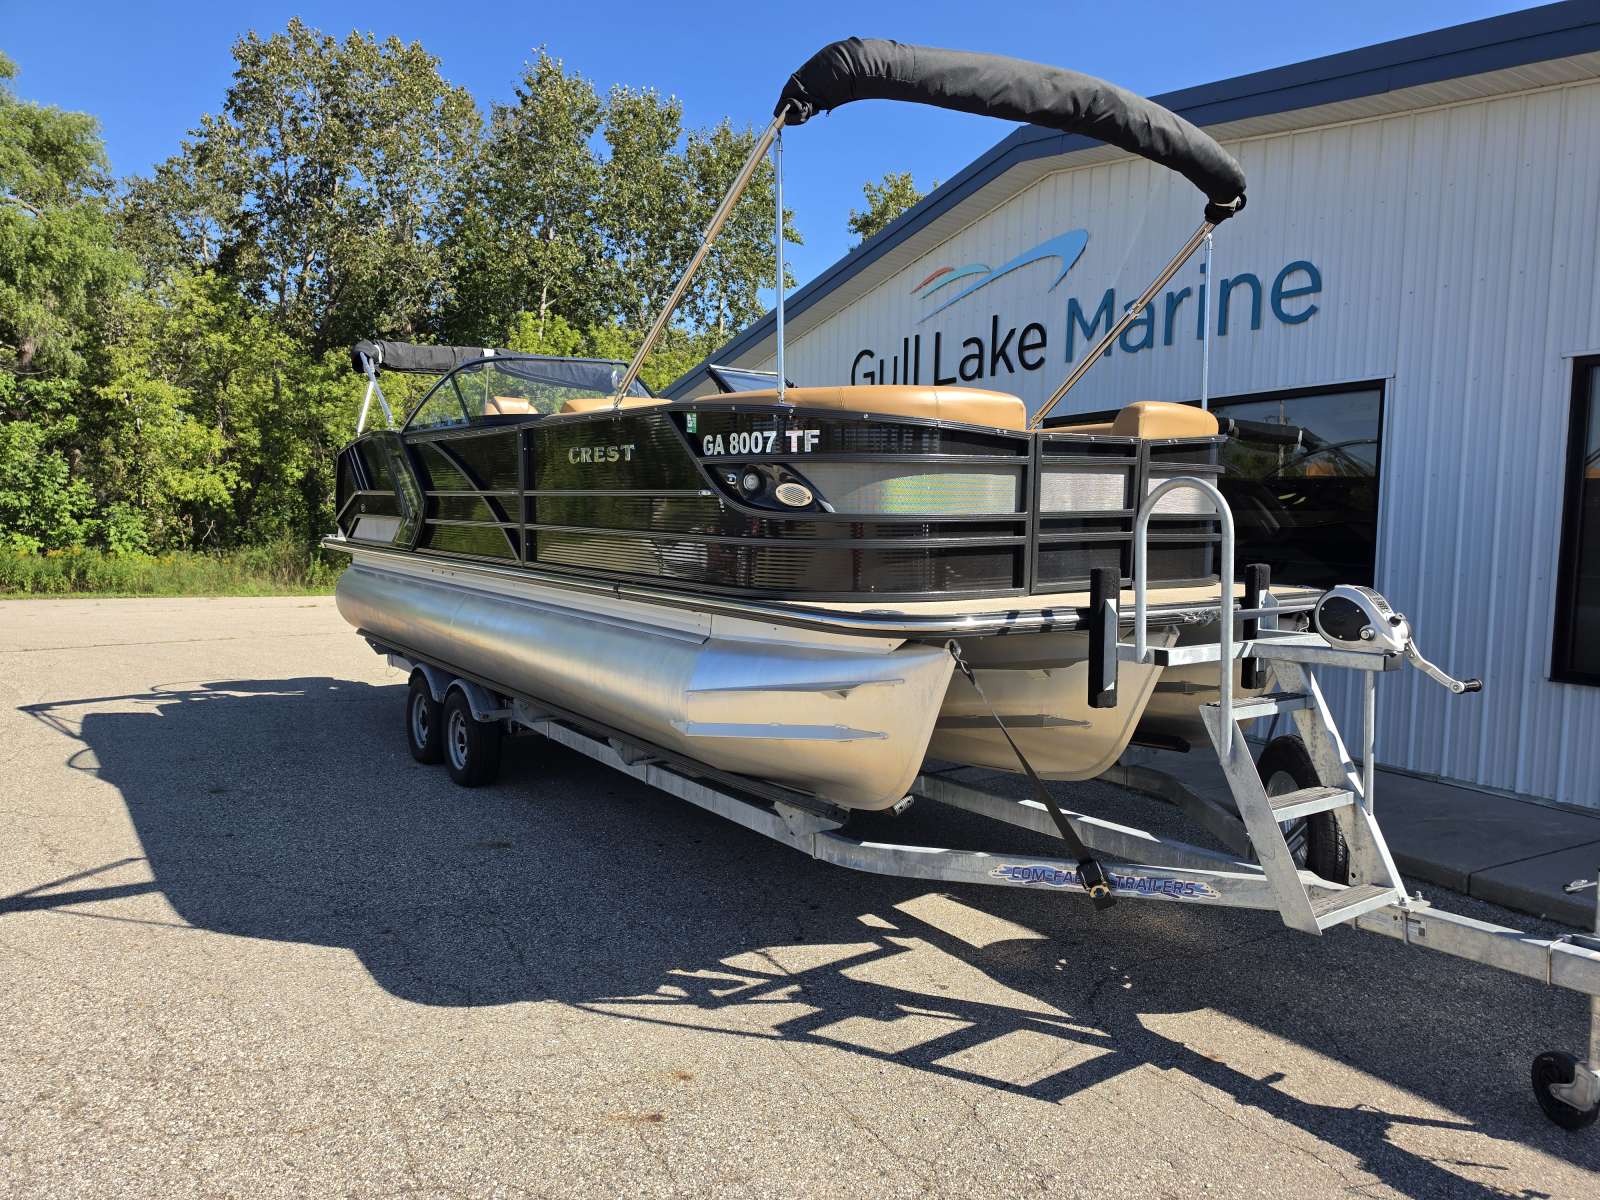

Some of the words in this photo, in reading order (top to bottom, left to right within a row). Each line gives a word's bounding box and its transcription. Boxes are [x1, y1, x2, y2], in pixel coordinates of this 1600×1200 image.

[851, 336, 920, 386] Gull
[933, 315, 1048, 386] Lake
[1065, 259, 1323, 363] Marine
[567, 444, 635, 464] CREST
[703, 434, 725, 456] GA
[730, 430, 777, 454] 8007
[785, 429, 820, 453] TF
[1115, 876, 1196, 895] TRAILERS
